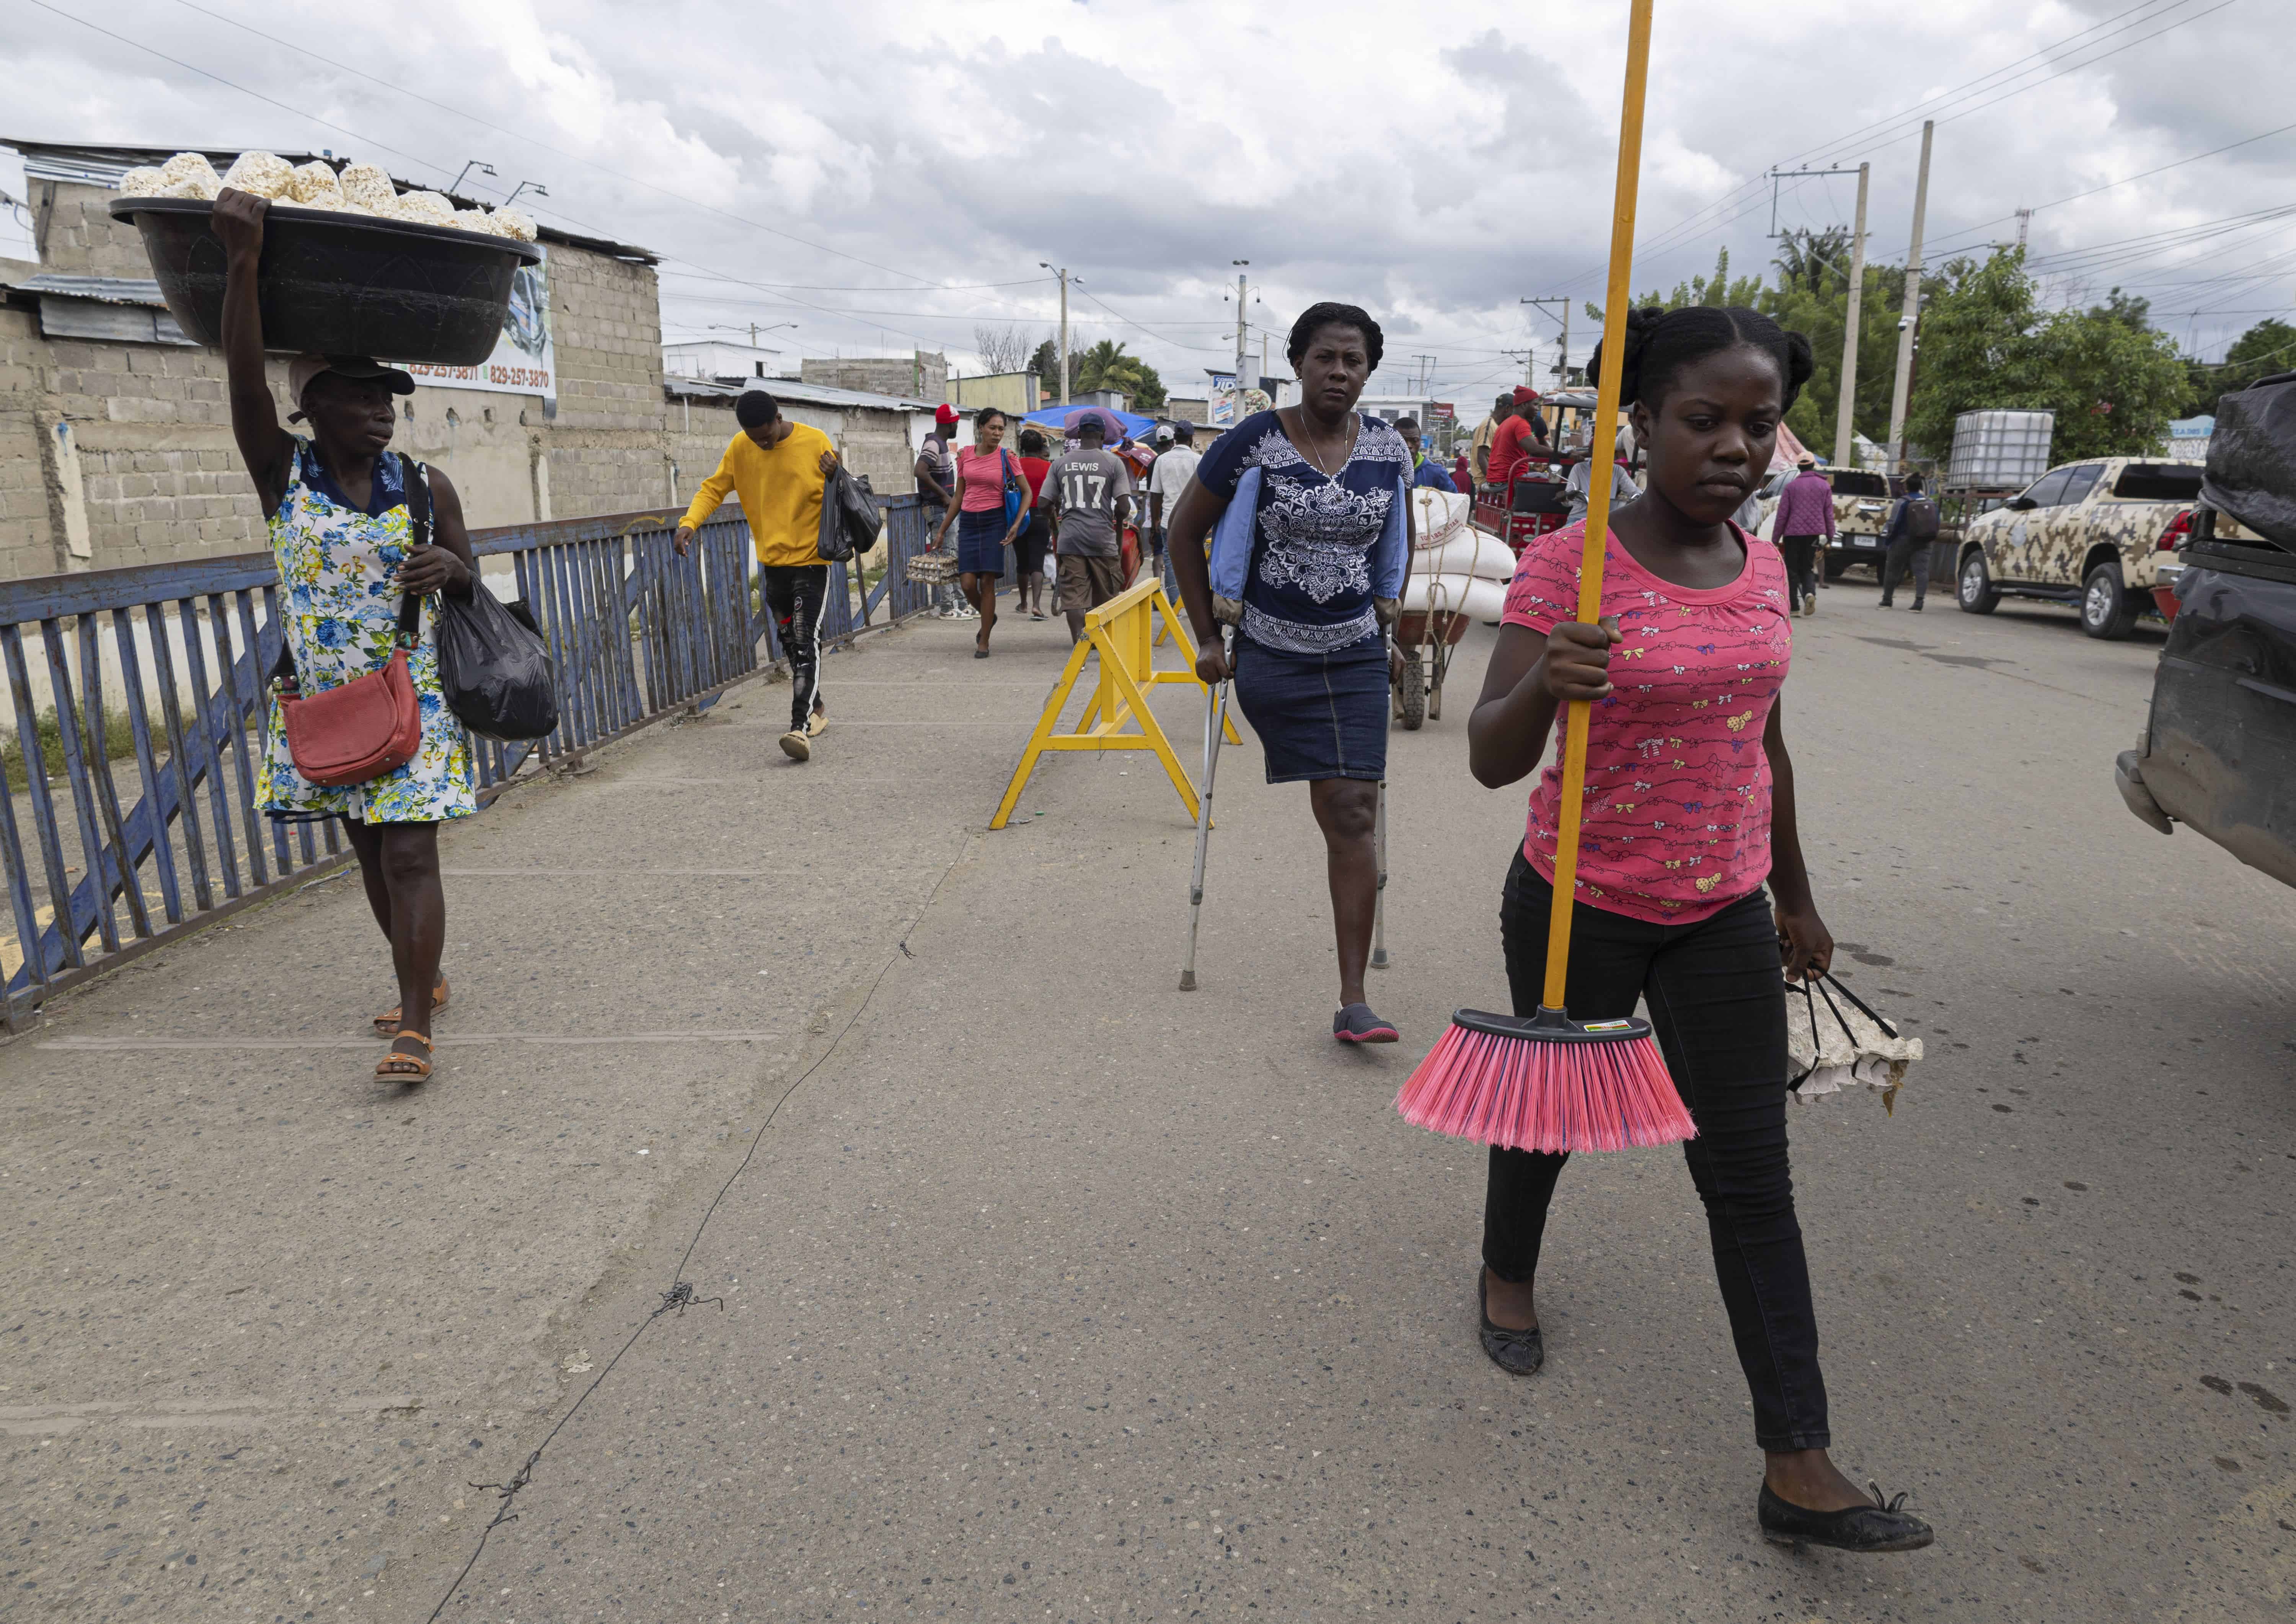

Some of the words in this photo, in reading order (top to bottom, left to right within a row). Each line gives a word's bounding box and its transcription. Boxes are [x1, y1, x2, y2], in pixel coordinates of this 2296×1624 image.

[410, 364, 478, 380] 829-257-3871
[490, 365, 548, 387] 829-257-3870
[1213, 382, 1236, 390] JID
[1065, 462, 1099, 471] LEWIS
[1062, 475, 1106, 509] 117
